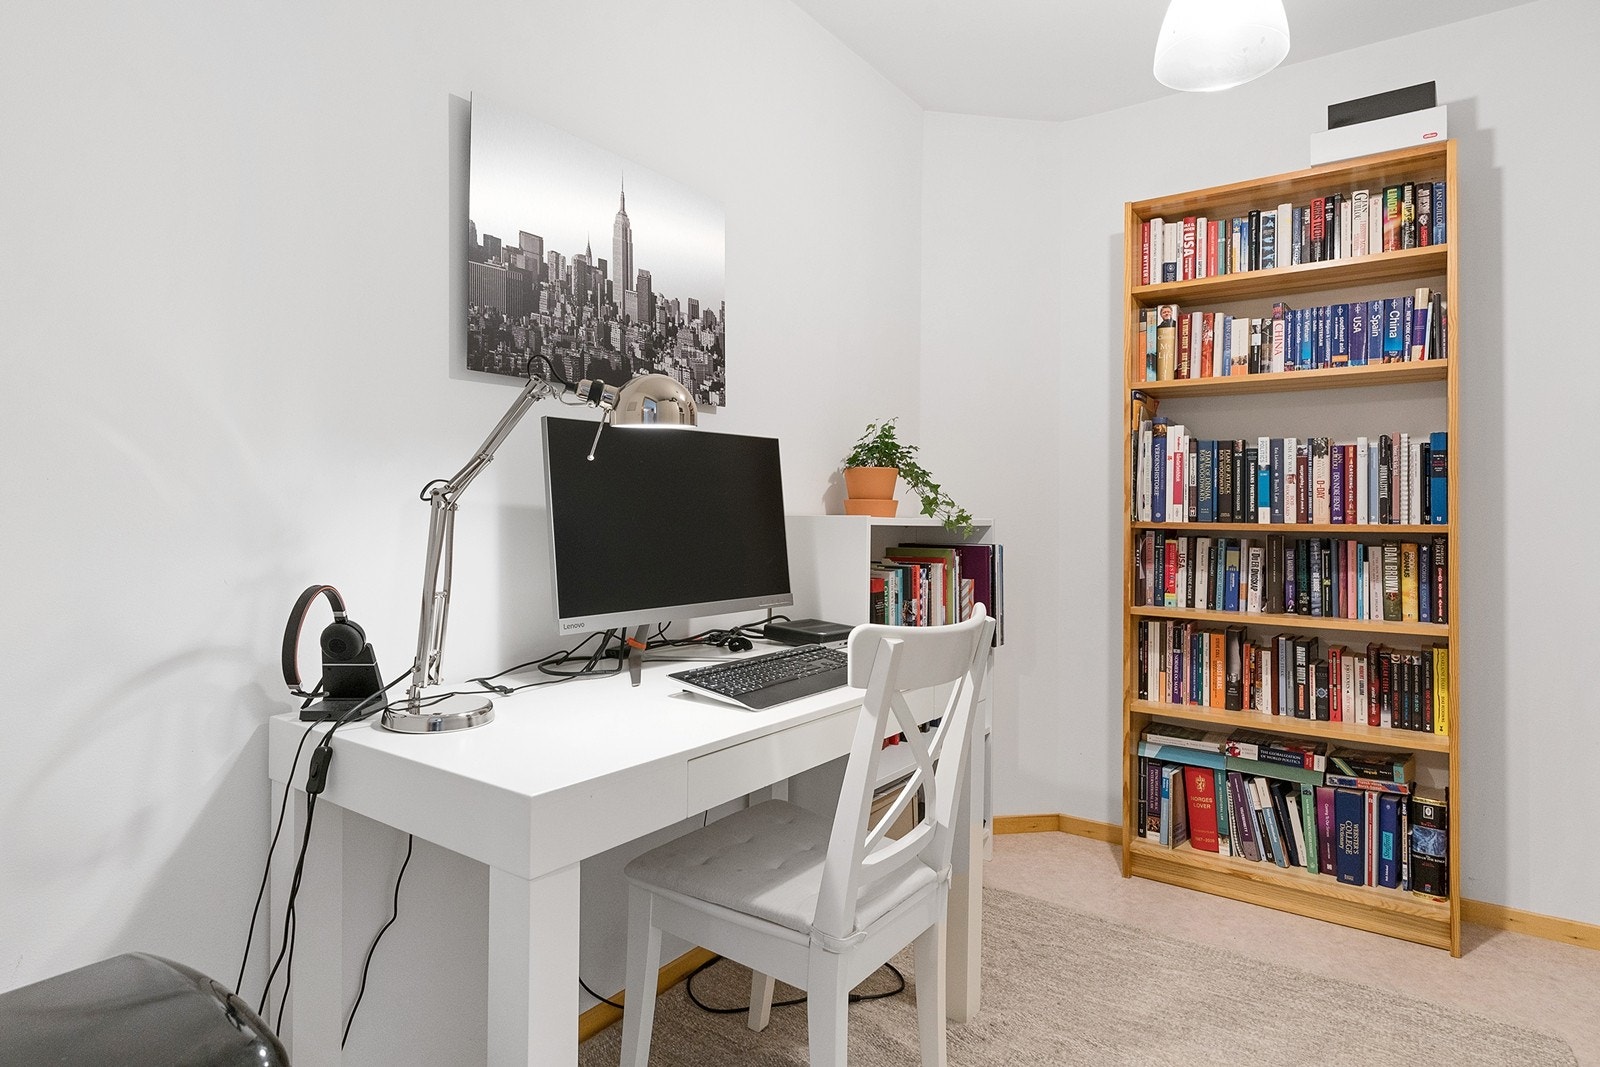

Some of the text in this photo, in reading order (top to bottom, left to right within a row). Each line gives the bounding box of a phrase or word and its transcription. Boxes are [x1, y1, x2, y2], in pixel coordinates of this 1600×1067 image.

[1387, 188, 1398, 220] LINDELL
[1183, 232, 1195, 257] USA
[1353, 316, 1362, 333] USA
[1370, 314, 1381, 337] Spain
[1389, 310, 1400, 338] China
[1274, 323, 1284, 356] CHINA
[1316, 480, 1325, 500] D-DAY
[1379, 464, 1388, 499] JOURNALISTIKK
[1178, 553, 1186, 569] USA
[1384, 547, 1398, 593] DAN BROWN
[563, 622, 585, 630] Lenovo
[1296, 646, 1306, 666] ANNE
[1296, 667, 1306, 685] HOLT
[1268, 750, 1301, 760] GLOBALIZATION
[1345, 820, 1353, 855] COLLEGE
